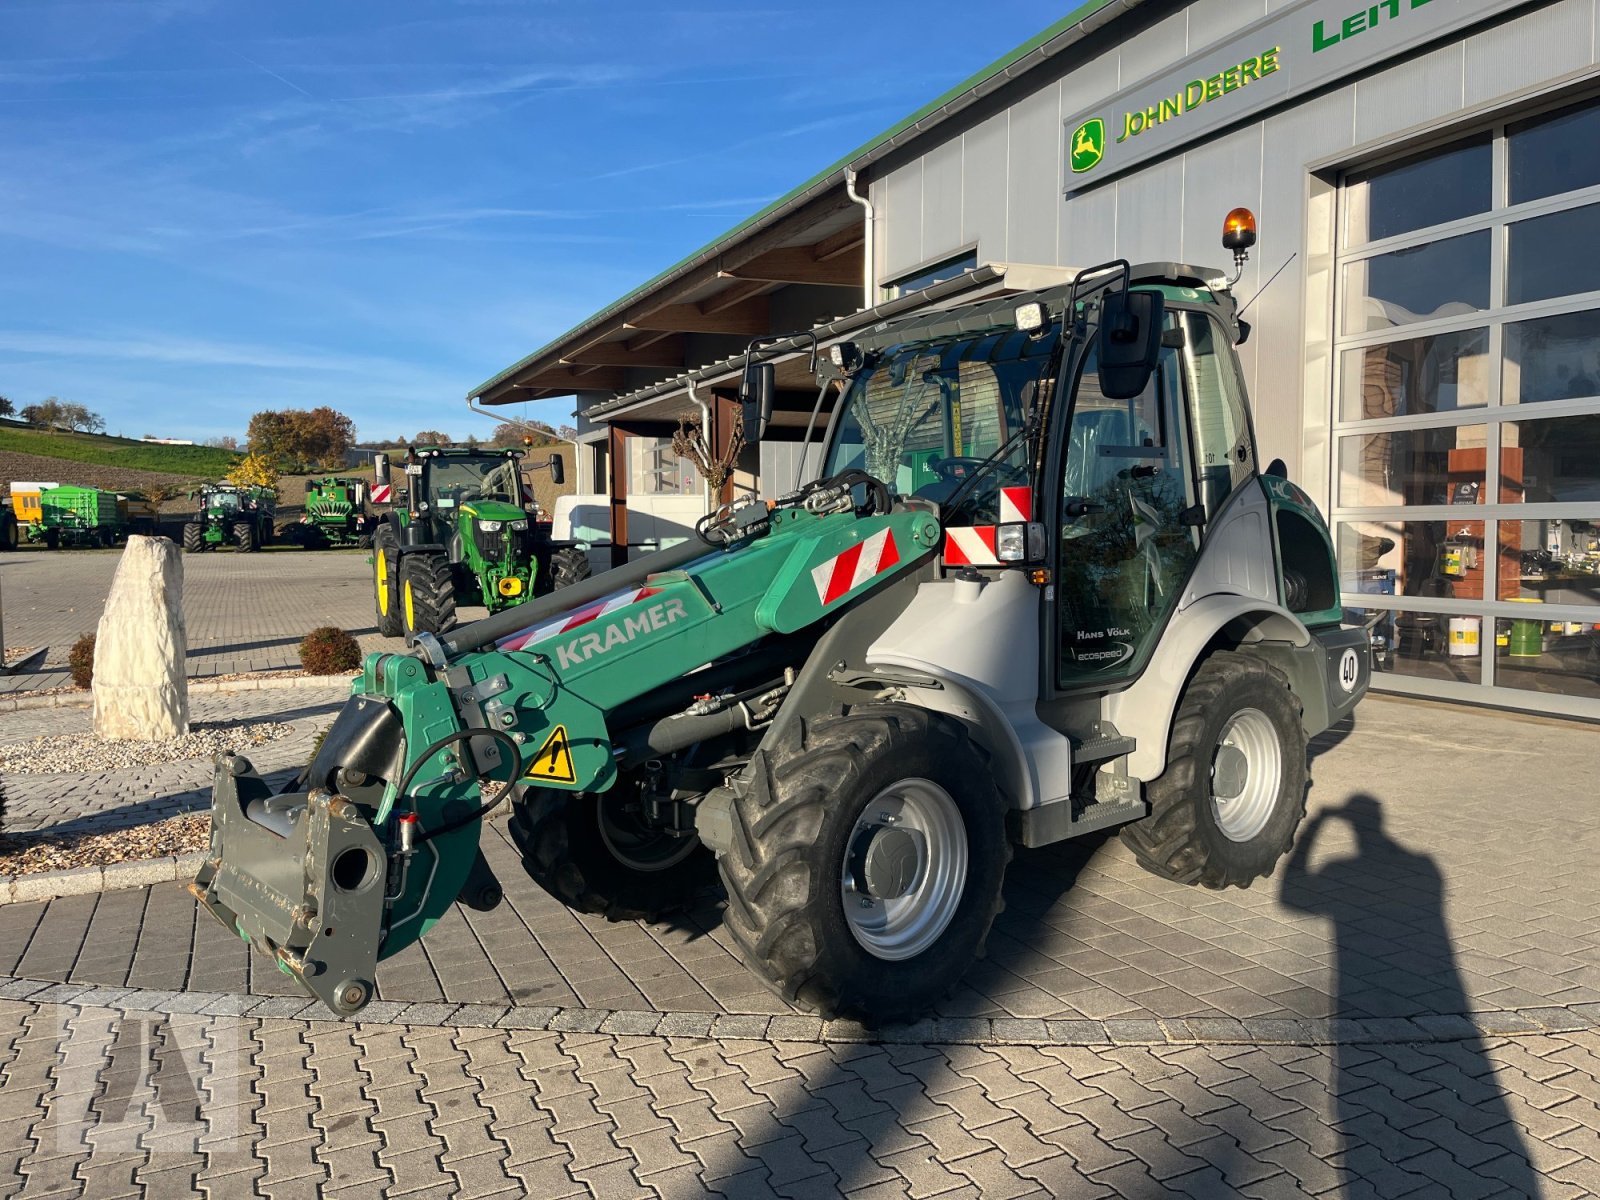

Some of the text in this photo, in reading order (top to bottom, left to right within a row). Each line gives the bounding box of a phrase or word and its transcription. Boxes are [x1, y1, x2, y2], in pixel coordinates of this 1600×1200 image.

[1116, 45, 1281, 143] JOHN DEERE
[556, 598, 688, 670] KRAMER
[1076, 627, 1130, 640] HANS VÖLK
[1077, 649, 1122, 661] ecospeed
[1343, 656, 1354, 683] 40
